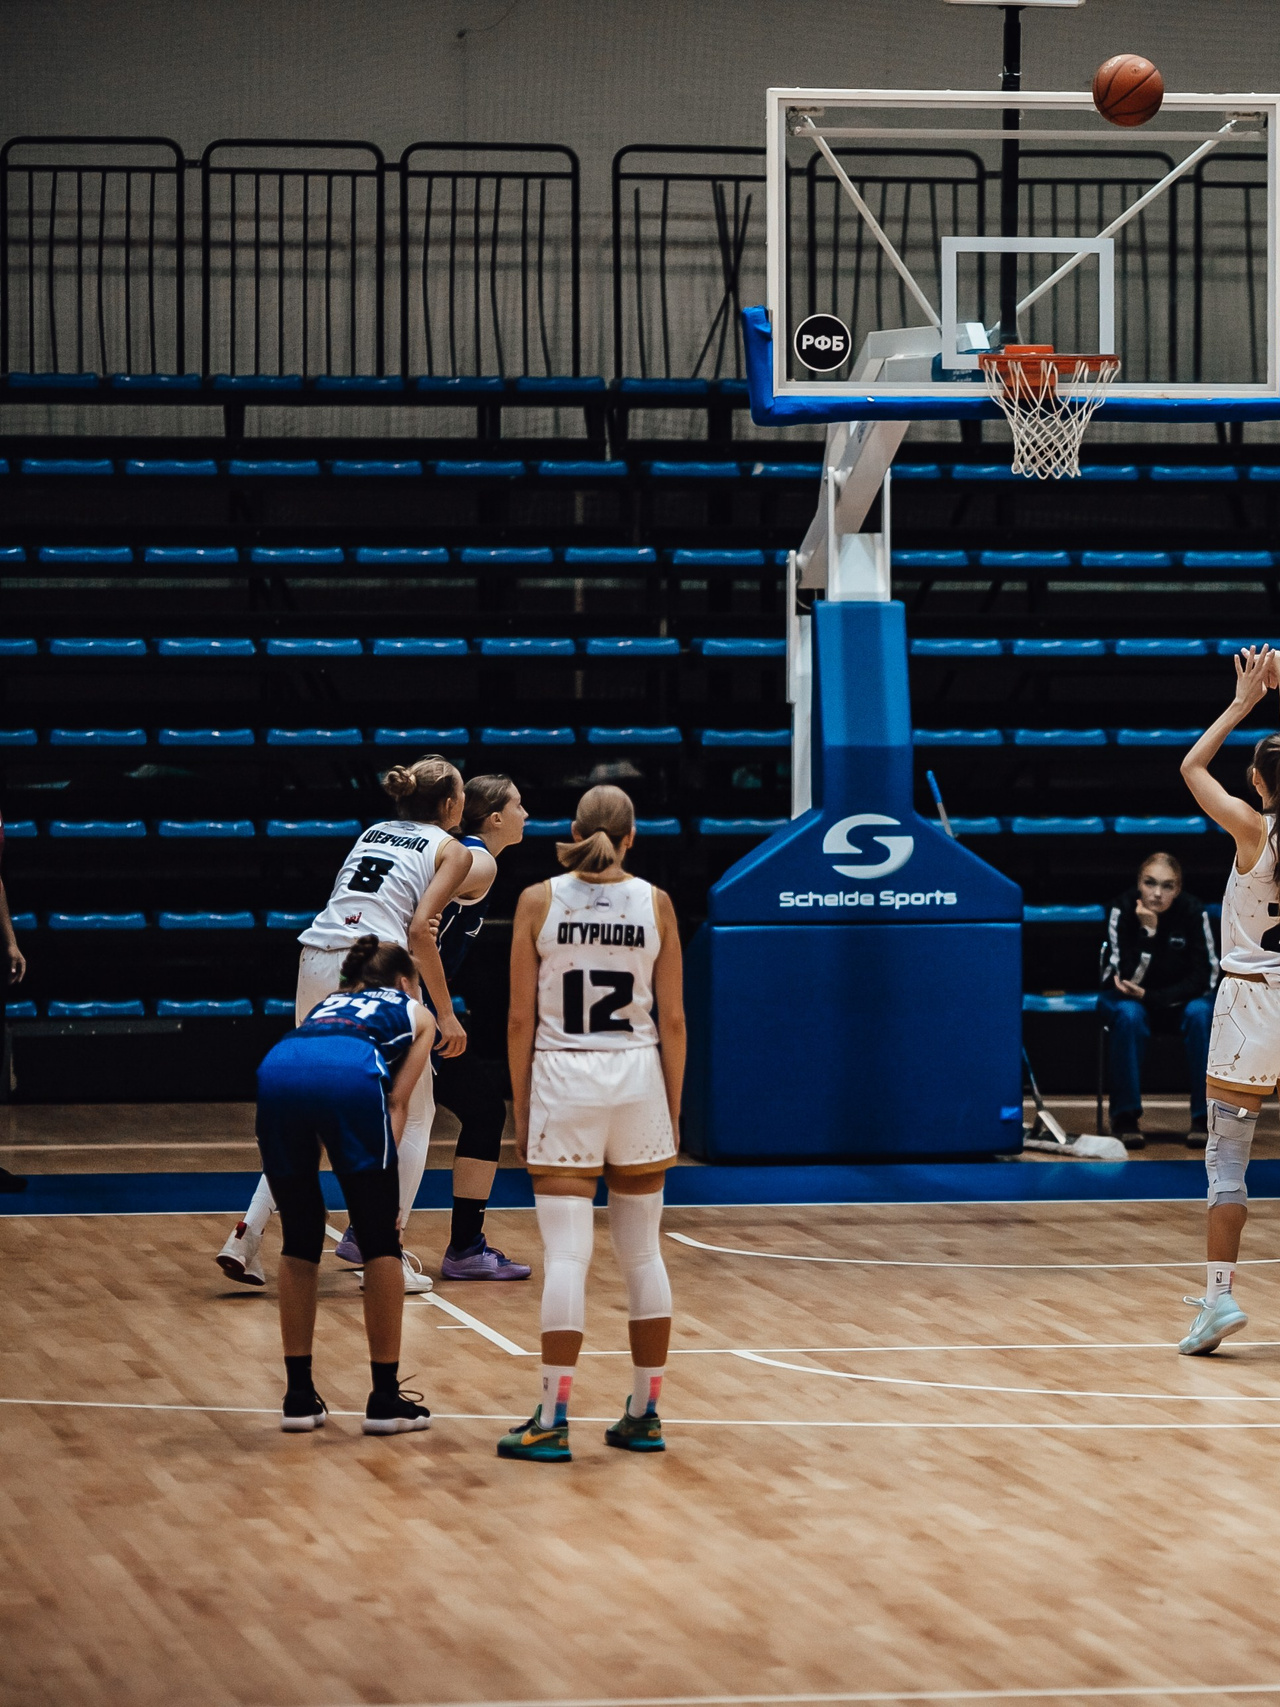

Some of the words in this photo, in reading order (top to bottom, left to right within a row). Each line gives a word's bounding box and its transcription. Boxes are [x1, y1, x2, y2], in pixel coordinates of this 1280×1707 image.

[802, 334, 845, 351] РФБ
[347, 856, 395, 893] 8
[779, 891, 874, 907] Schelde
[879, 890, 957, 909] Sports
[557, 922, 645, 948] ОГУРЦОВА
[311, 997, 381, 1019] 24
[562, 969, 634, 1034] 12
